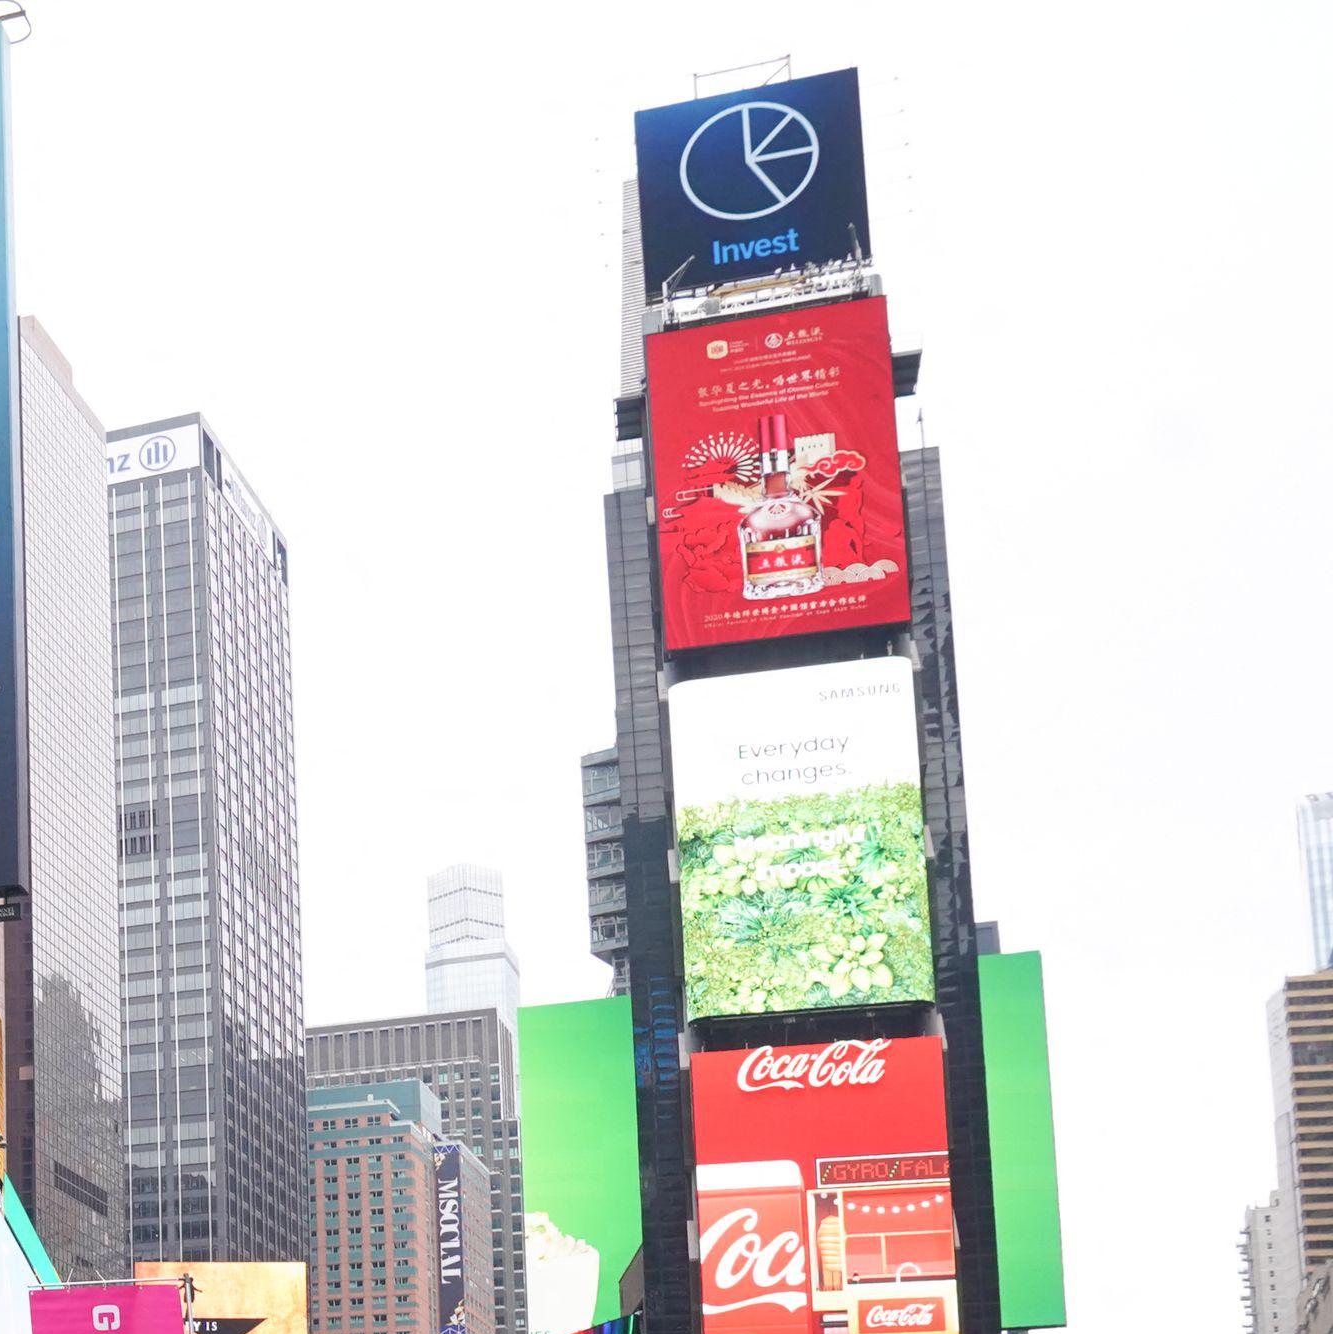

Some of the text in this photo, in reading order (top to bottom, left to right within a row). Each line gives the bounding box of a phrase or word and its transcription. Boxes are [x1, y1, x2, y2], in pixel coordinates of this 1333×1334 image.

[713, 228, 799, 265] Invest
[819, 683, 900, 701] SAMSUNG
[739, 736, 848, 759] Everyday
[736, 1038, 893, 1092] Coca-Cola
[205, 1321, 218, 1331] IS
[866, 1303, 936, 1327] Coca-Cola
